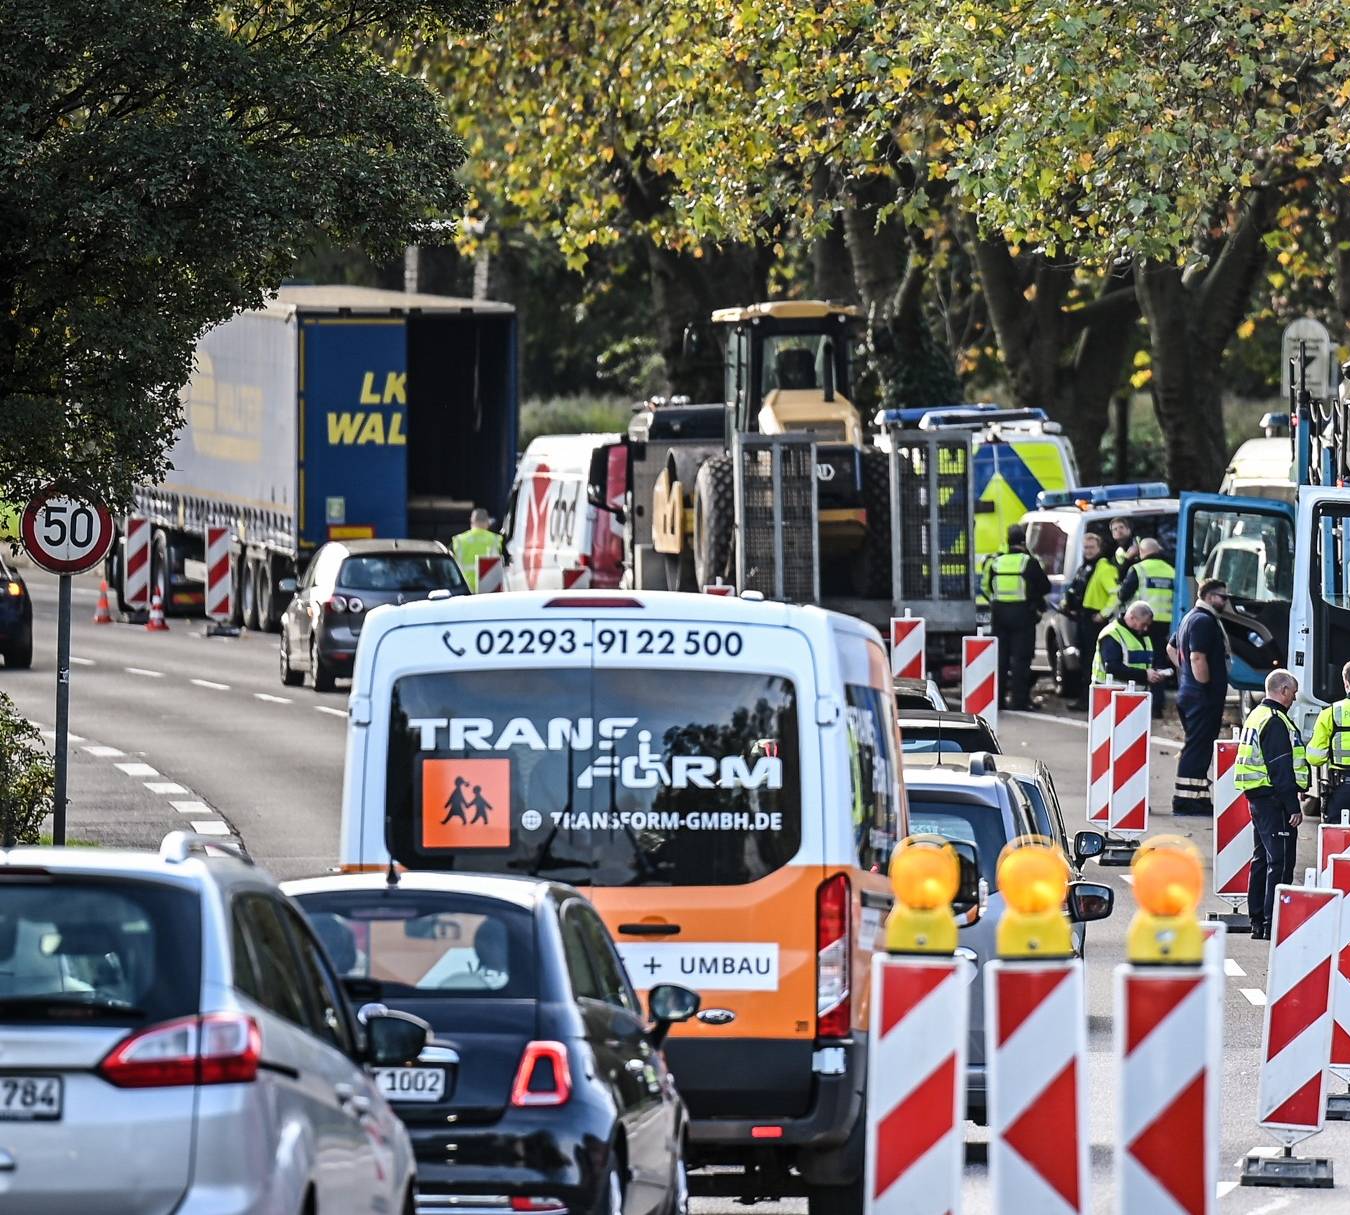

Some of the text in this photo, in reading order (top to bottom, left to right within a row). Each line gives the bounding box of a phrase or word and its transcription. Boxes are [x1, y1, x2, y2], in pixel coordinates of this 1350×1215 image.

[43, 506, 94, 548] 50
[683, 630, 743, 656] 500
[408, 717, 639, 751] TRANS
[576, 755, 783, 789] FORM
[550, 811, 783, 832] TRANSFORM-GMBH.DE
[680, 956, 771, 975] UMBAU
[3, 1080, 54, 1107] 784
[385, 1071, 440, 1092] 1002
